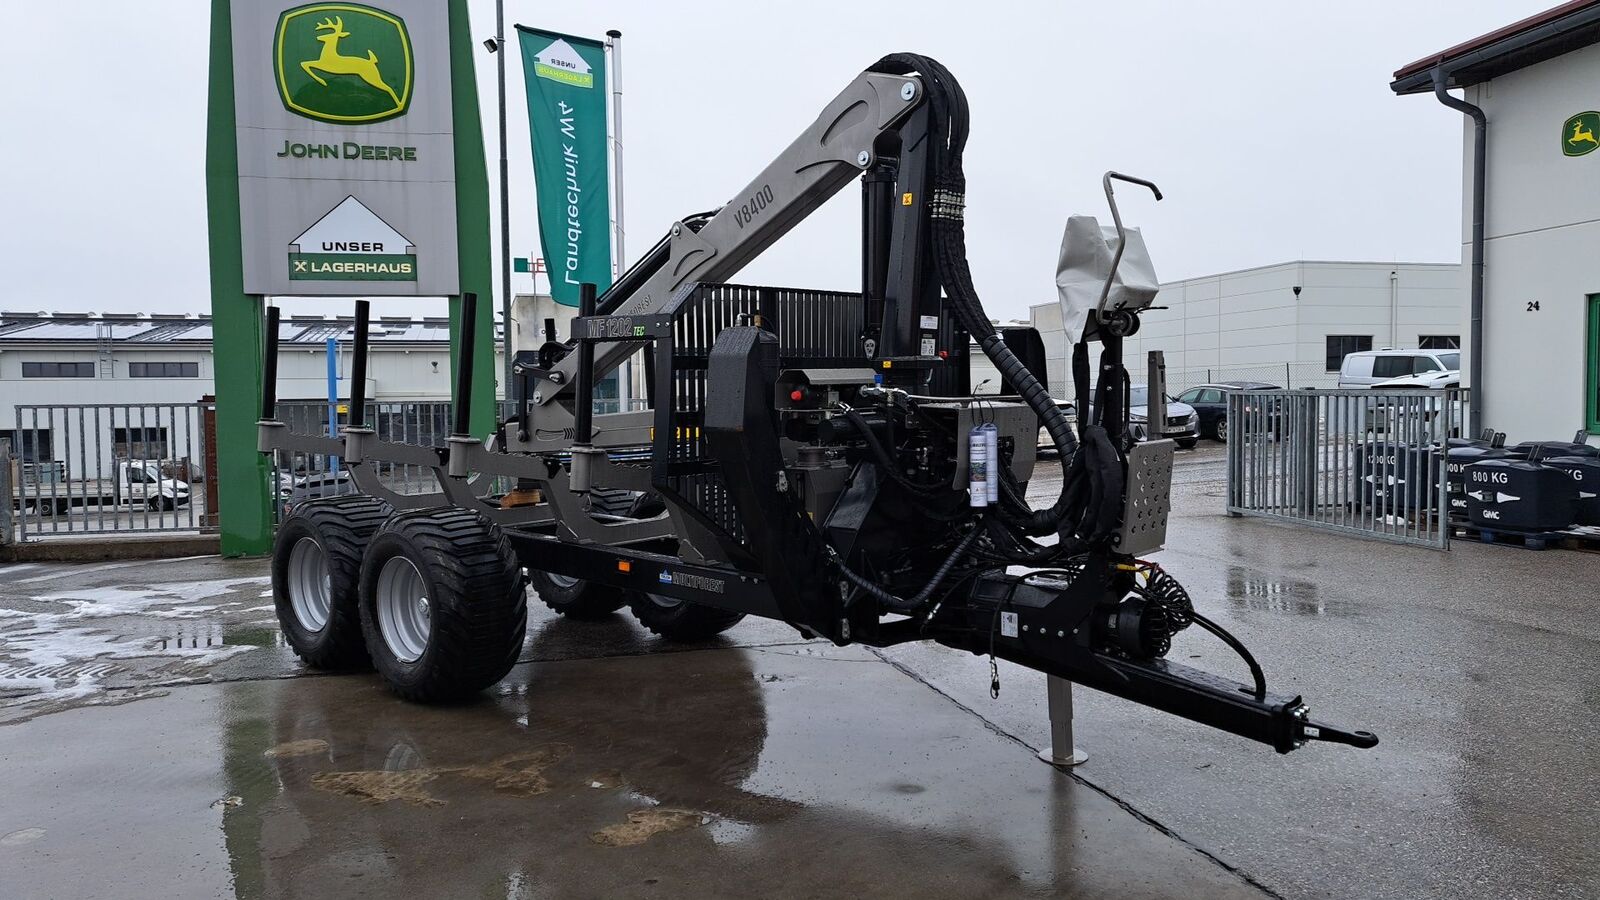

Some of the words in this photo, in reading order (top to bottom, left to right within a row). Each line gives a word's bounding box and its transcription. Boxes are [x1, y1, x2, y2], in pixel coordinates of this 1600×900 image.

[277, 140, 339, 159] JOHN
[343, 142, 417, 162] DEERE
[734, 184, 774, 229] V8400
[322, 242, 384, 252] UNSER
[311, 262, 412, 273] LAGERHAUS
[1526, 301, 1540, 311] 24
[587, 319, 605, 338] MF
[606, 317, 633, 338] 1202
[633, 326, 645, 337] TEC
[1472, 471, 1488, 482] 800
[1491, 472, 1508, 484] KG
[1451, 499, 1467, 508] GMC
[1483, 510, 1500, 520] GMC
